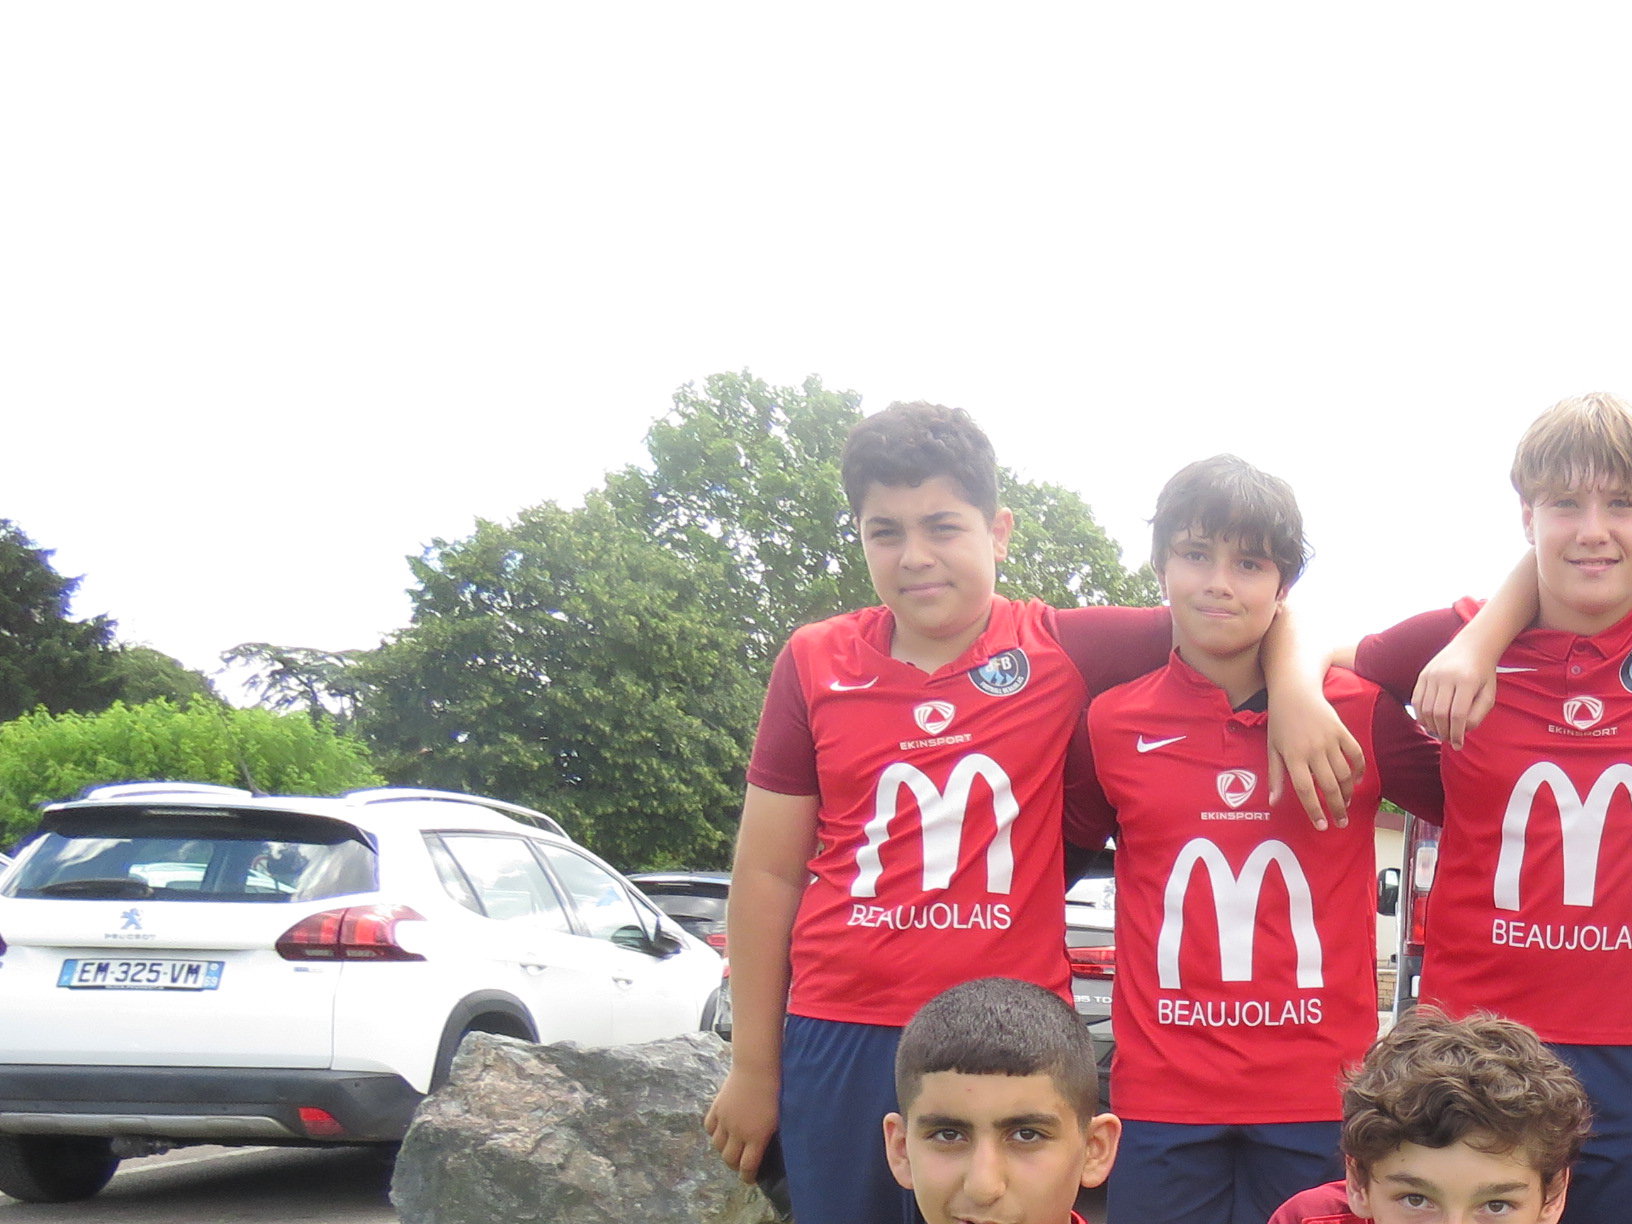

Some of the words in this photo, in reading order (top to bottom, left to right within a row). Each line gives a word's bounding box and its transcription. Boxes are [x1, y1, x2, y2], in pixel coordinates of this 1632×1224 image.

[1548, 724, 1618, 737] EKINSPORT
[900, 733, 972, 751] EKINSPORT
[1201, 811, 1271, 822] EKINSPORT
[847, 903, 1012, 930] BEAUJOLAIS
[1158, 998, 1323, 1028] BEAUJOLAIS
